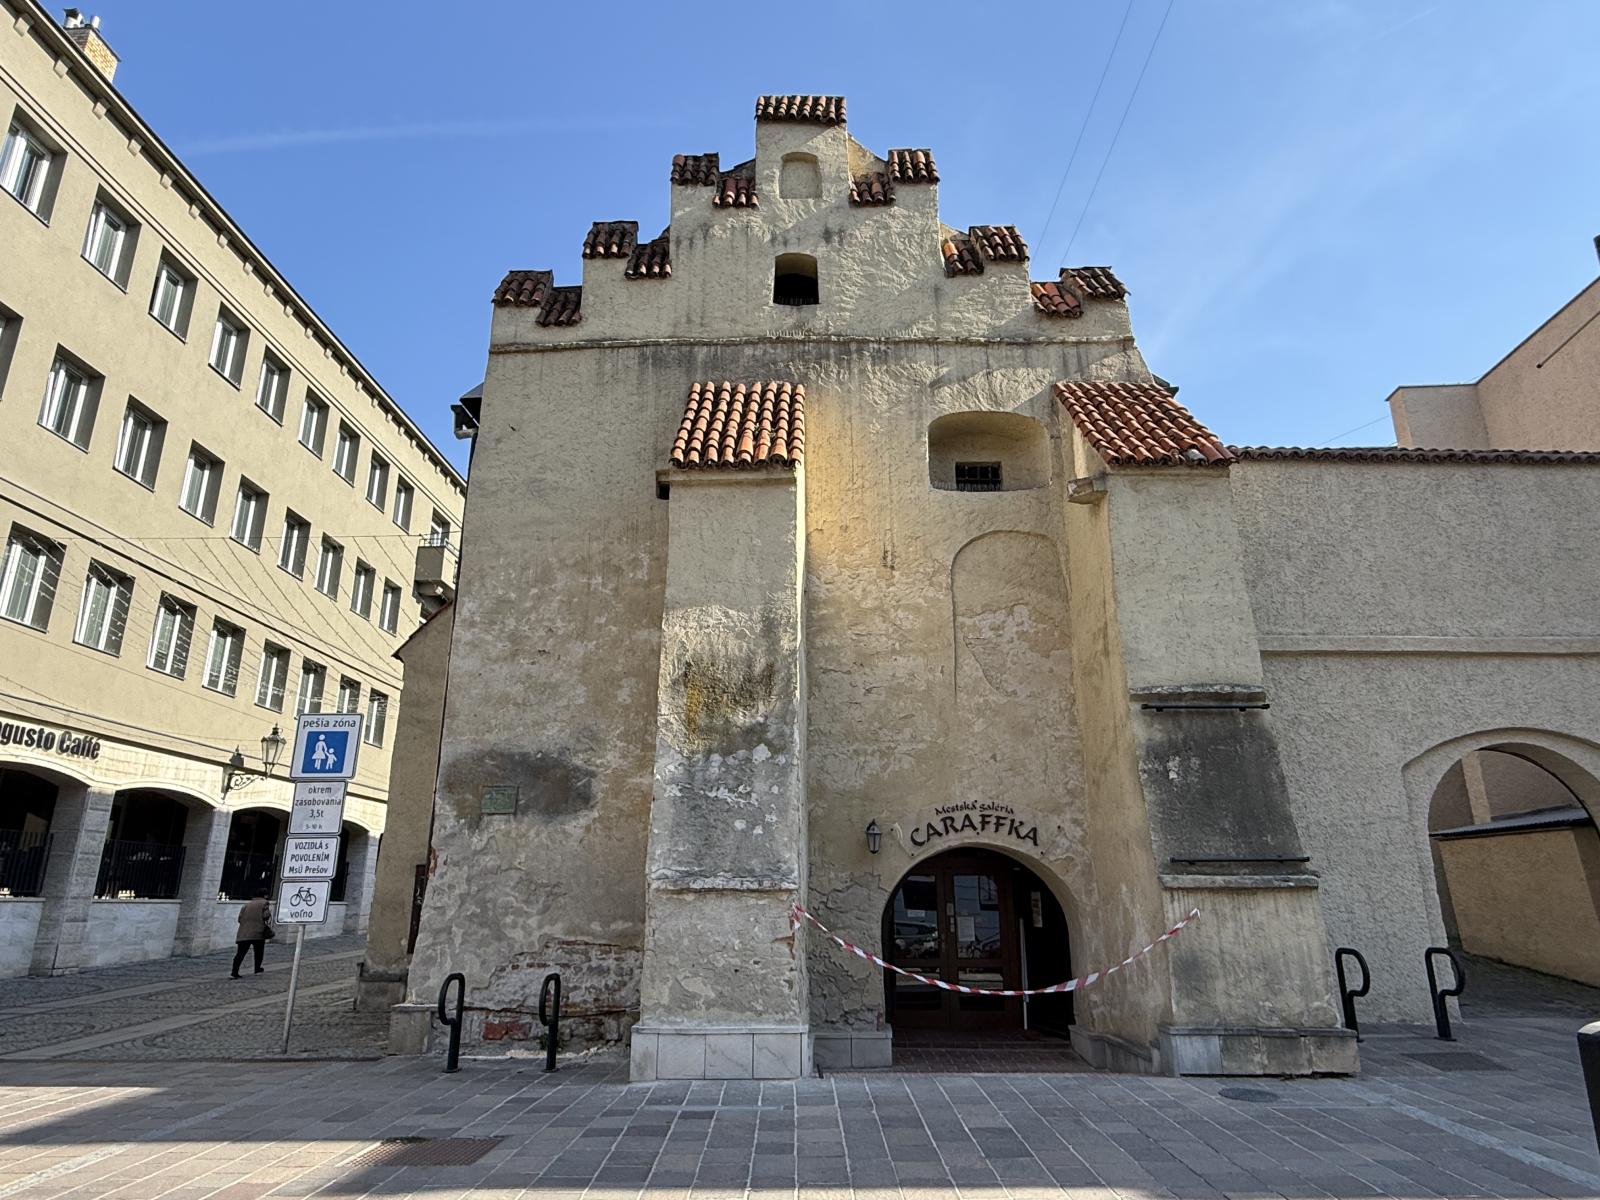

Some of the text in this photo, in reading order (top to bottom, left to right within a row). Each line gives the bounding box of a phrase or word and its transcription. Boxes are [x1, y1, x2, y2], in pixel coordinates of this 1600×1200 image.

[303, 717, 356, 729] pešia zóna
[0, 721, 101, 760] gusto Caffé
[308, 786, 332, 794] okrem
[935, 800, 1014, 816] Mestská galéria
[309, 809, 324, 819] 3,5t
[910, 813, 1039, 847] CARAFFKA
[295, 841, 323, 850] VOZIDLÁ
[291, 851, 329, 862] POVOLENÍM
[305, 864, 328, 874] Prešov
[290, 908, 313, 918] voľno
